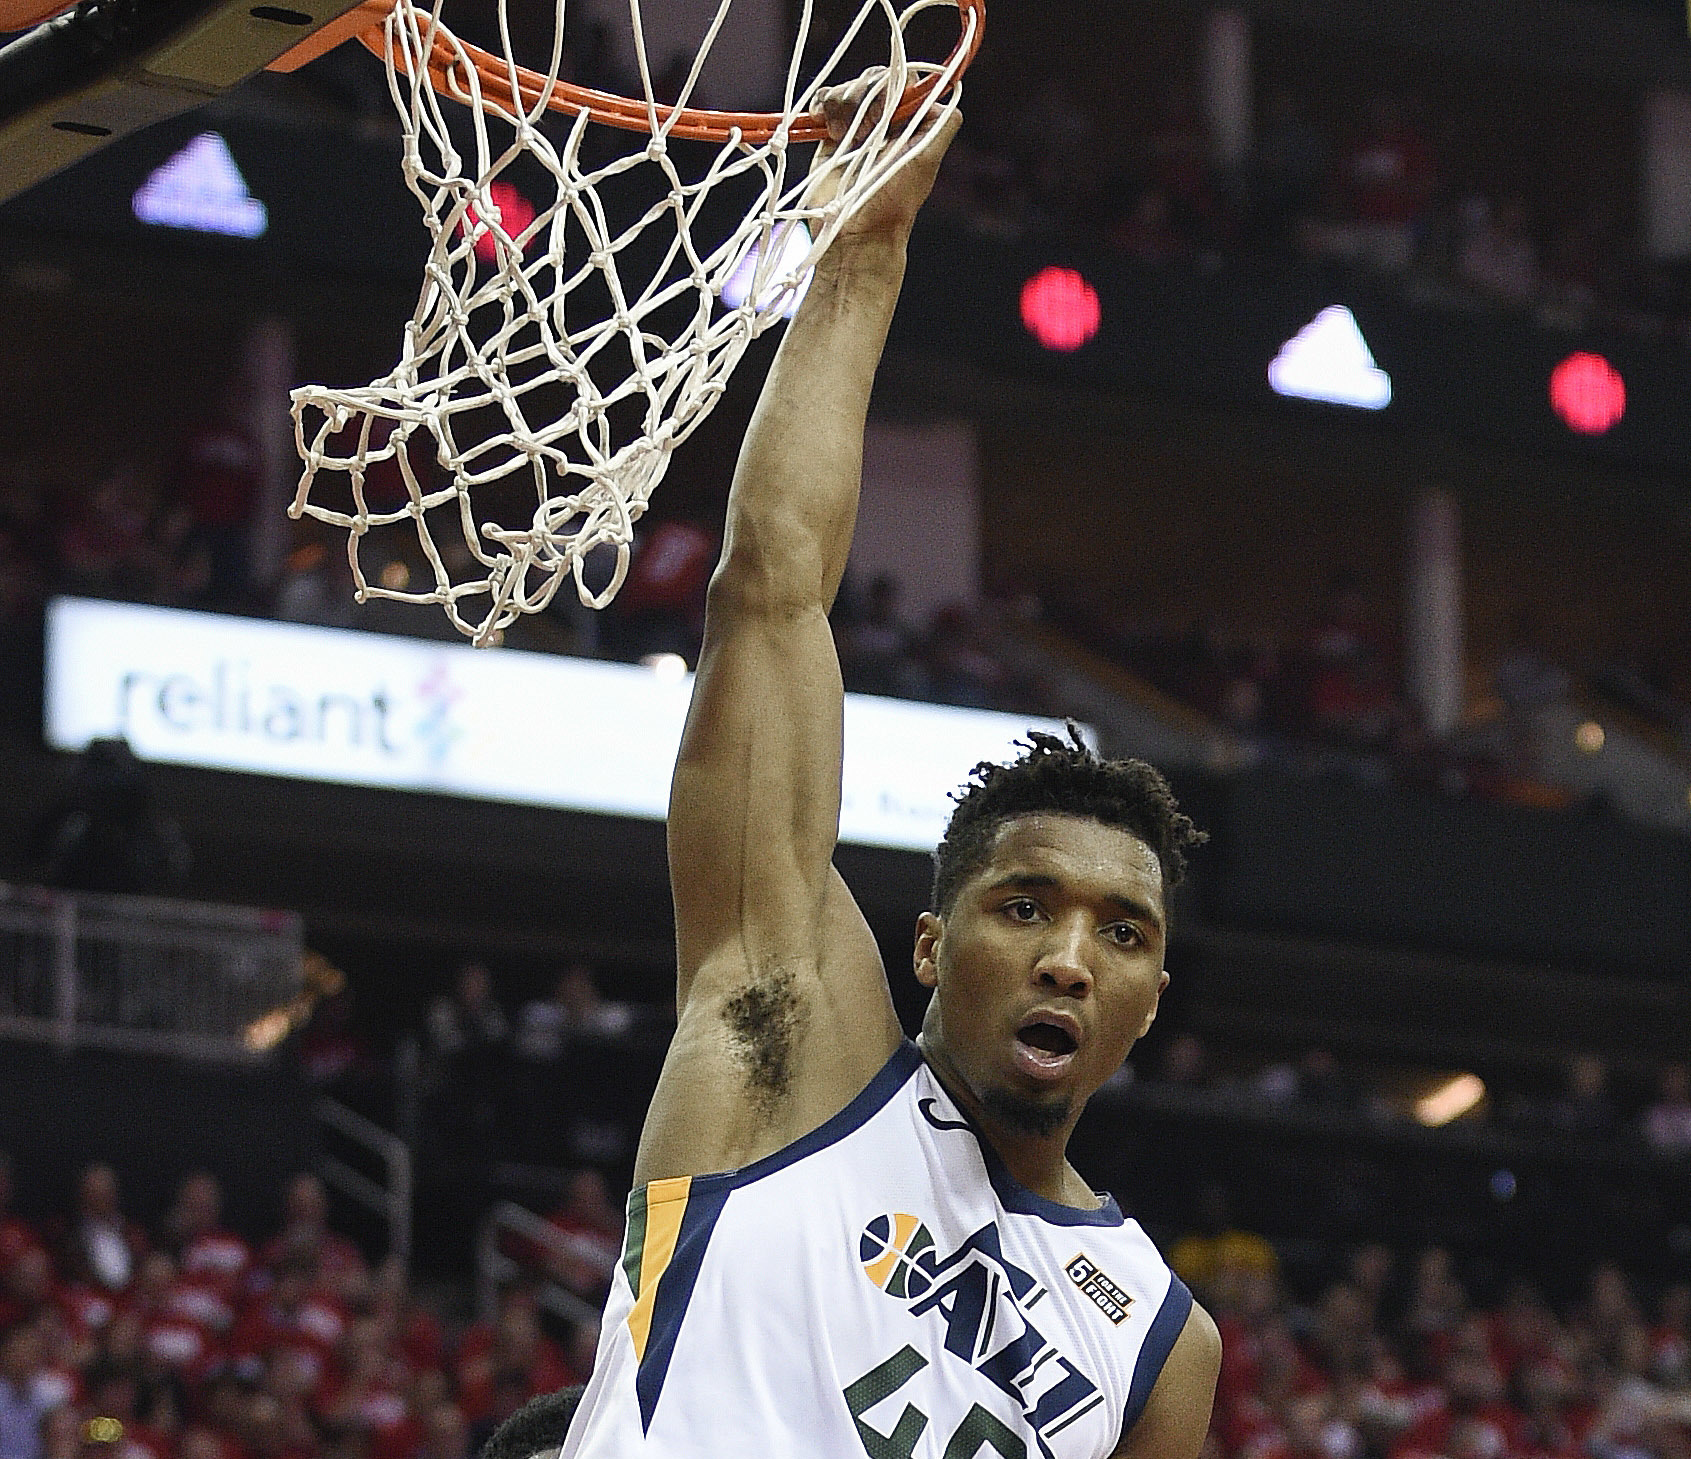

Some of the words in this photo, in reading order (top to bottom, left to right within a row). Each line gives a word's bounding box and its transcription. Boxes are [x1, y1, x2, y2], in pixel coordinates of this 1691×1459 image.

[117, 658, 402, 754] reliant
[1069, 1259, 1094, 1283] 5
[1085, 1284, 1124, 1320] FIGHT
[1096, 1276, 1114, 1292] FOR
[1111, 1289, 1128, 1304] THE
